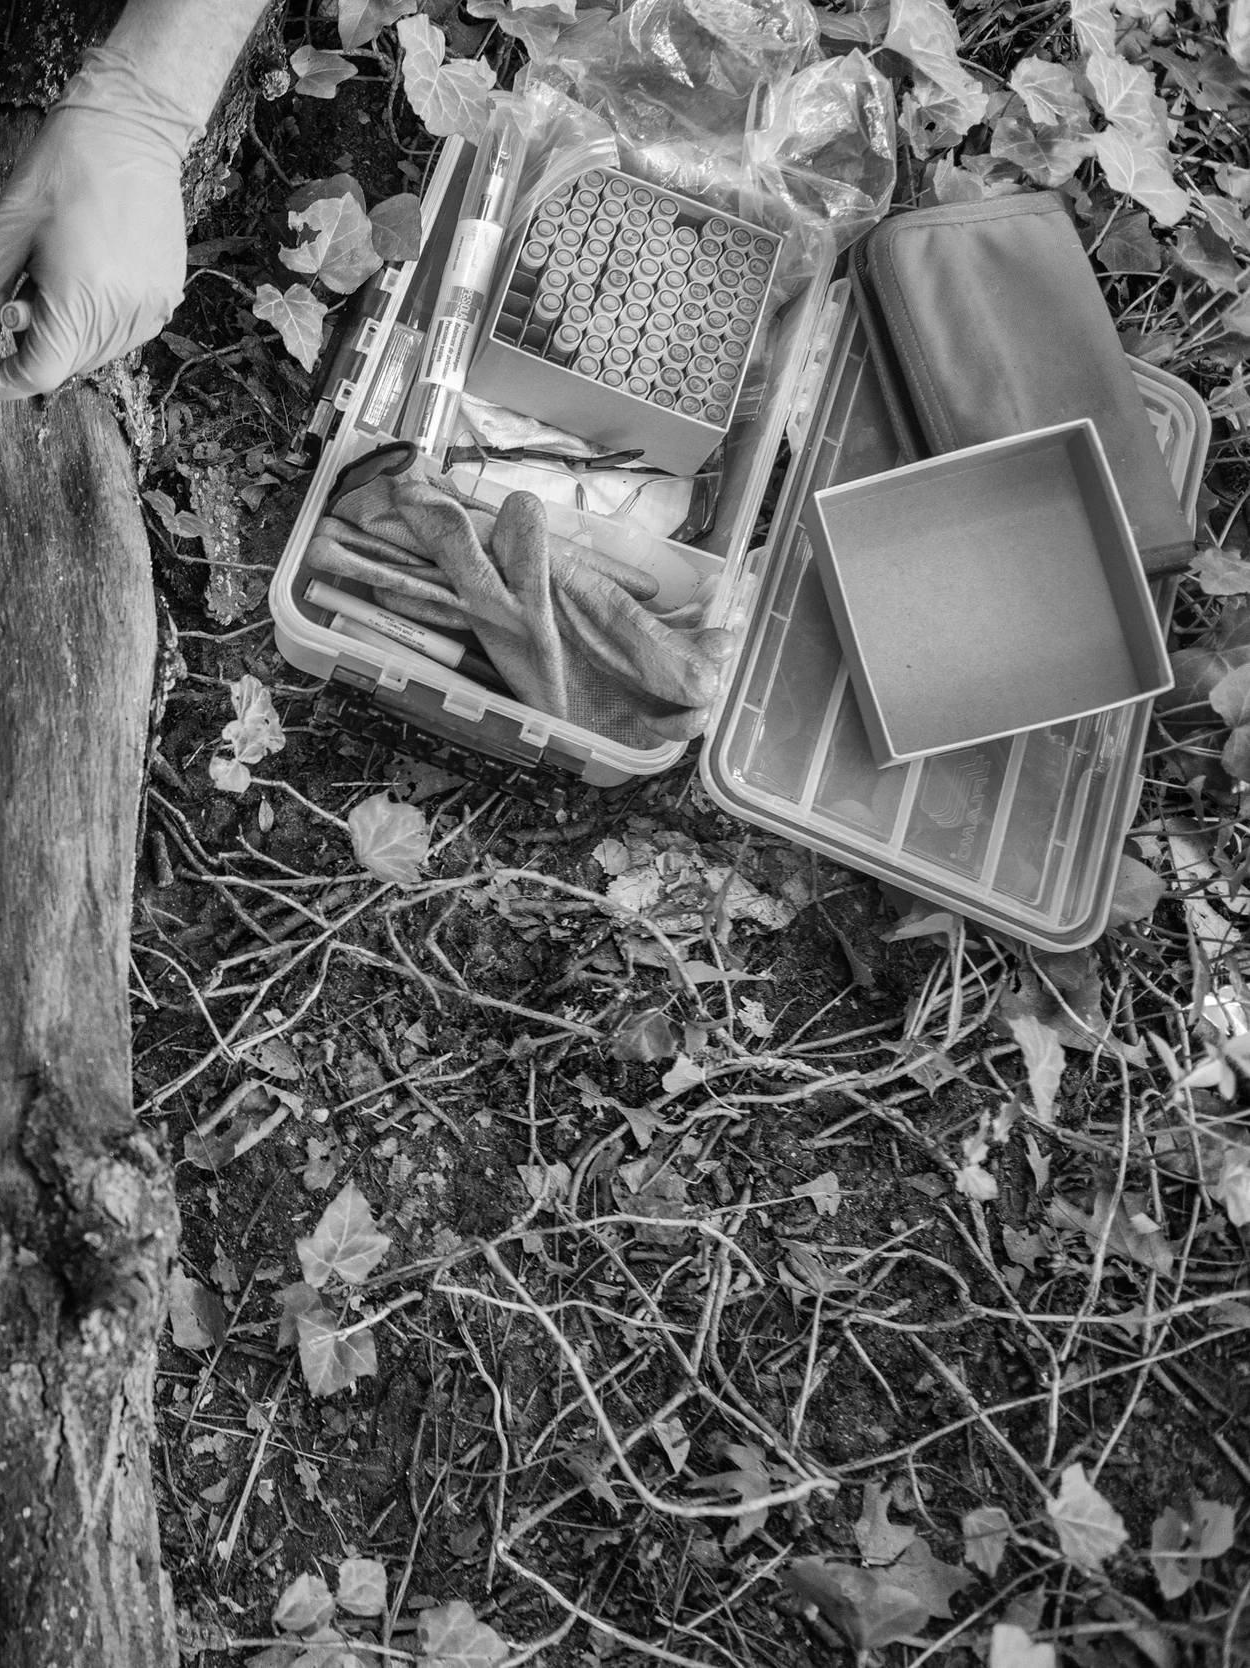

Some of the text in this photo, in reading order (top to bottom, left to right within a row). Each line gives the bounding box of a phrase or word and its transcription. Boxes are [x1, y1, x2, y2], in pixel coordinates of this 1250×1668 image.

[456, 287, 474, 320] PESOLA
[436, 320, 452, 363] Precision scales
[448, 346, 454, 355] de
